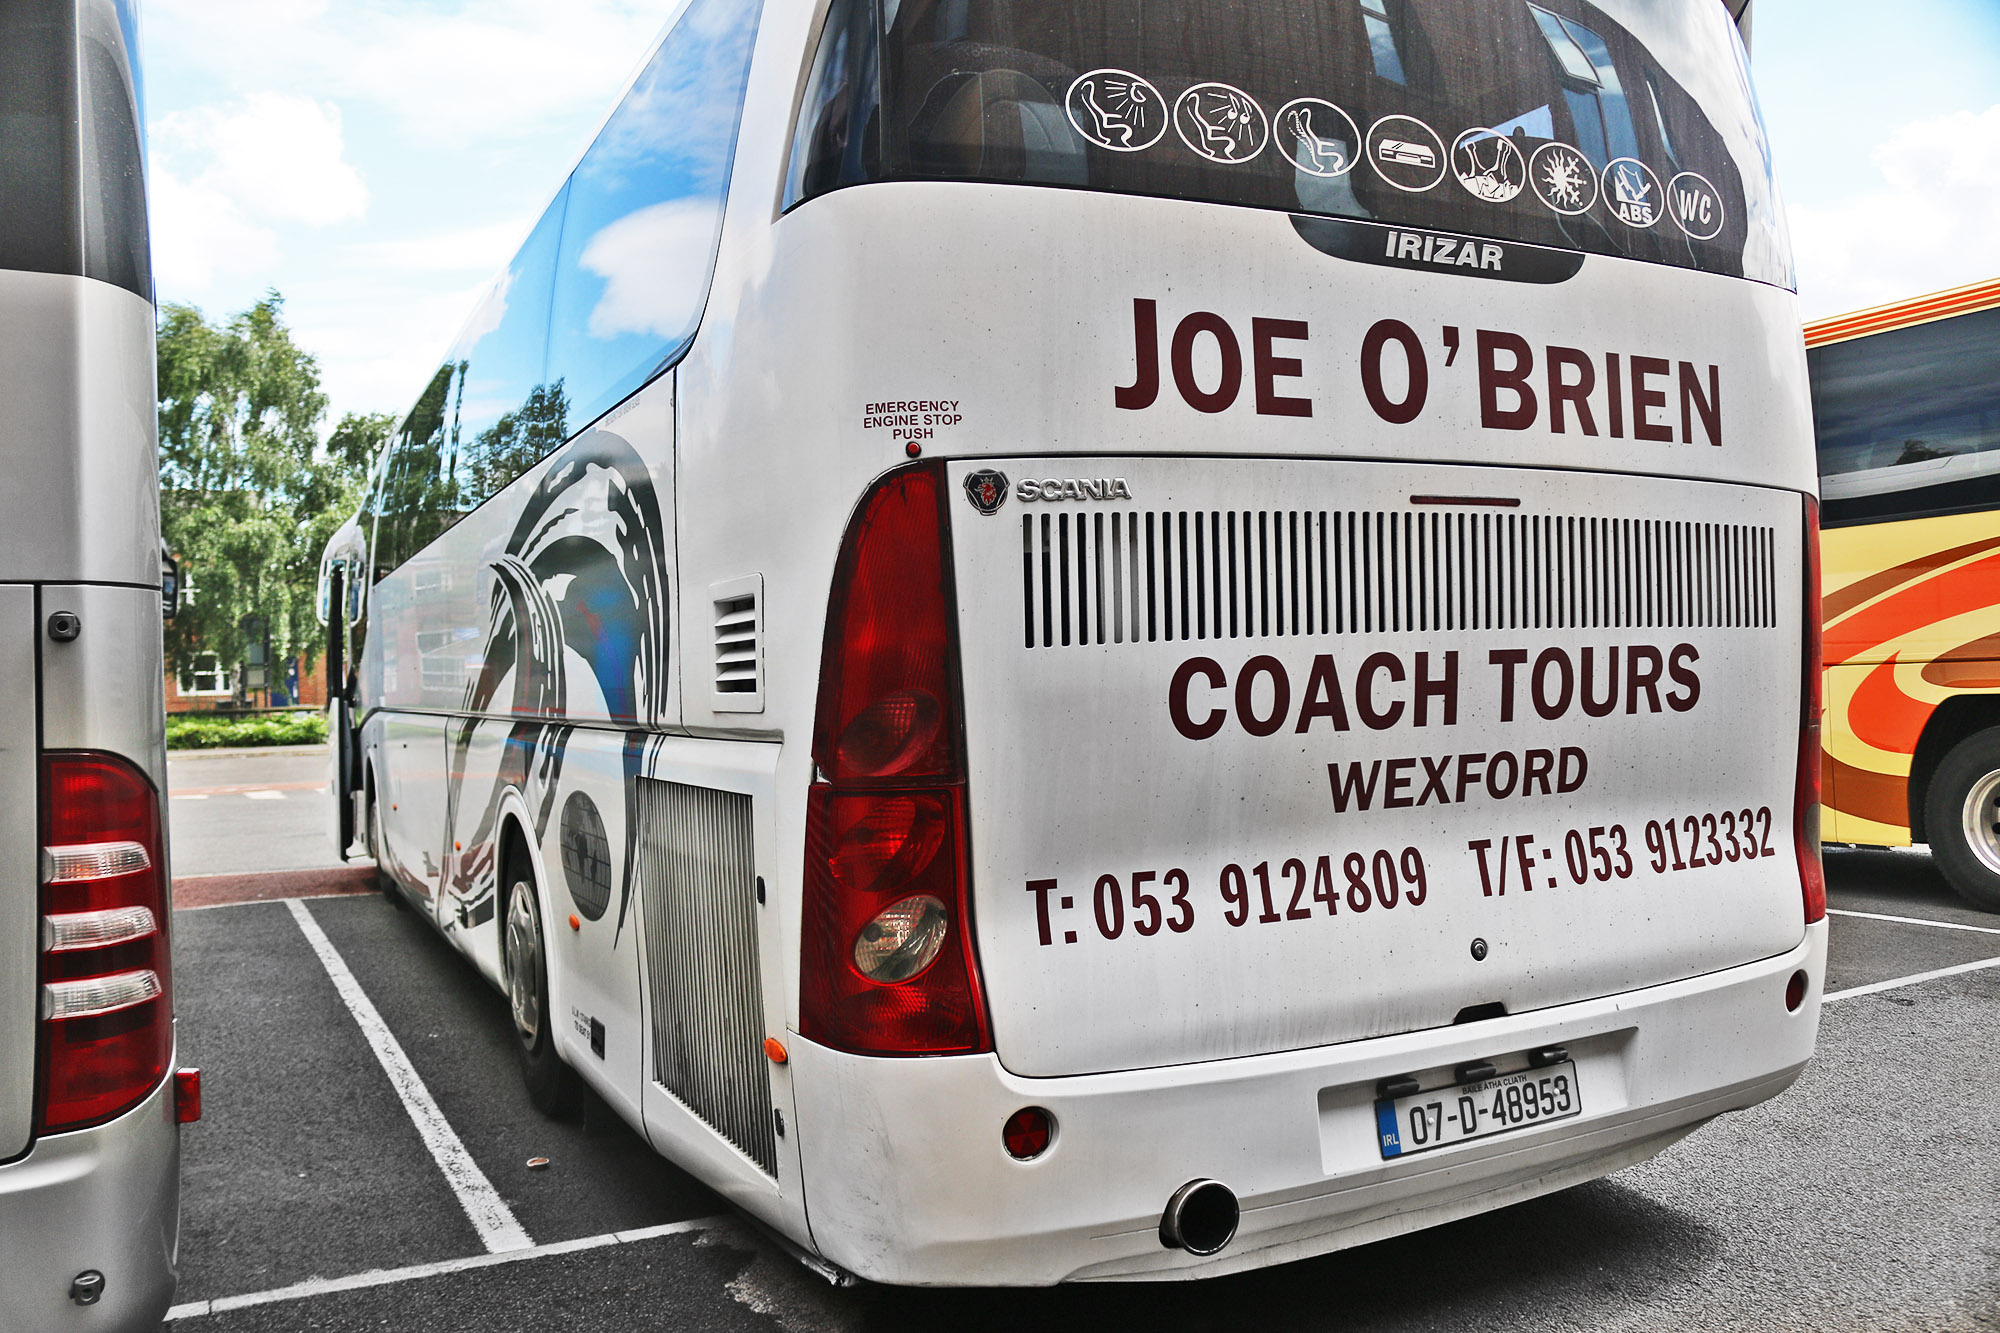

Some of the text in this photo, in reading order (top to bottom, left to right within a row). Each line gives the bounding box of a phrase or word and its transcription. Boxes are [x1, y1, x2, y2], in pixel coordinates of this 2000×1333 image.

[1618, 203, 1654, 224] ABS
[1680, 189, 1712, 225] WC
[1385, 231, 1504, 272] IRIZAR
[1115, 298, 1722, 447] JOE O'BRIEN
[863, 413, 963, 429] ENGINE STOP
[865, 400, 960, 415] EMERGENCY
[892, 428, 934, 440] PUSH
[1016, 477, 1132, 502] SCANIA
[1168, 643, 1701, 740] COACH TOURS
[1327, 746, 1589, 814] WEXFORD
[1468, 805, 1776, 898] T/F: 053 9123332
[1025, 846, 1428, 946] T: 053 9124809
[1462, 1083, 1484, 1095] BAILE
[1503, 1073, 1528, 1087] CLIATH
[1409, 1074, 1572, 1146] 07-D-48953
[1383, 1133, 1400, 1147] IRL
